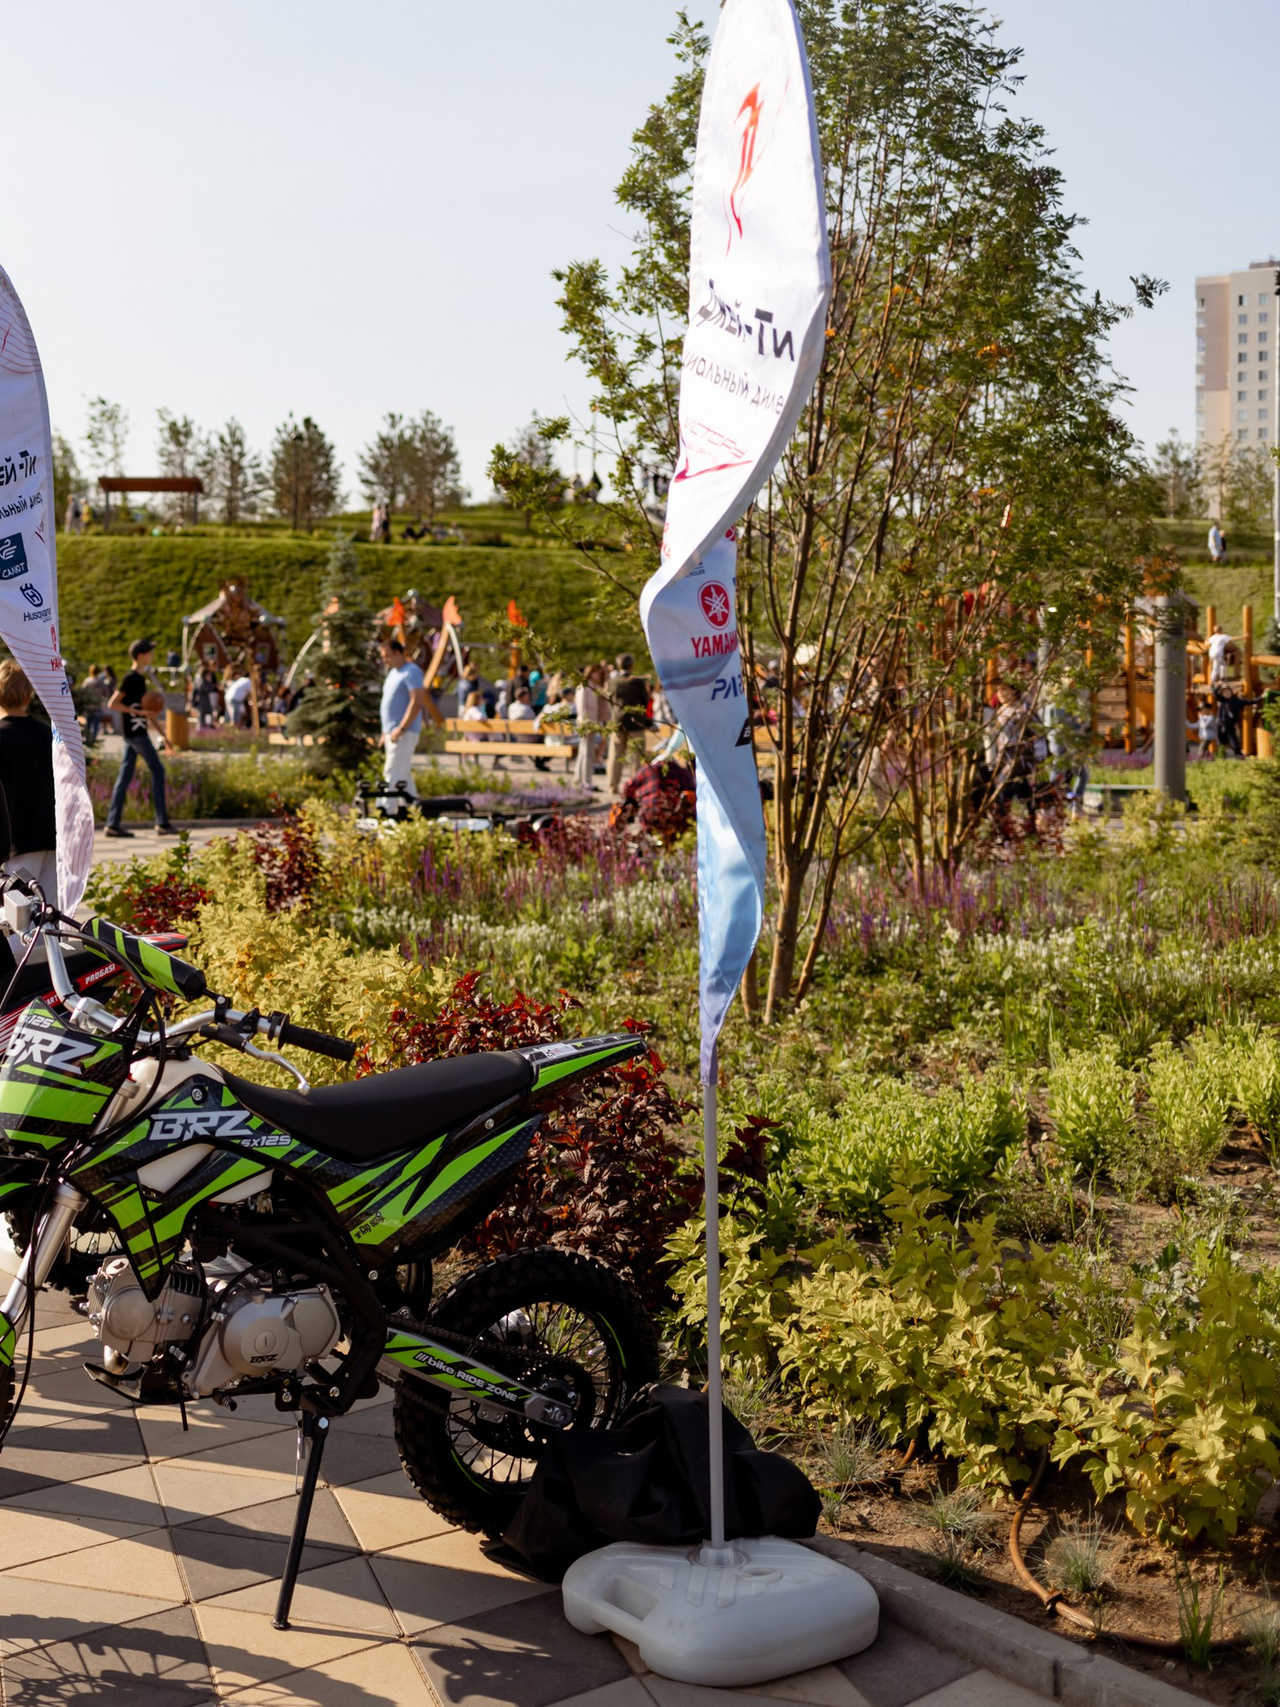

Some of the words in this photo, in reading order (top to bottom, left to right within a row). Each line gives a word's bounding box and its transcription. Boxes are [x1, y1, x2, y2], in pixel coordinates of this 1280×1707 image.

[751, 386, 784, 415] диле
[690, 630, 739, 658] YAMAH
[85, 964, 115, 985] PROGASI
[5, 1026, 96, 1075] BRZ
[150, 1110, 253, 1142] BRZ
[249, 1353, 278, 1364] BRZ
[427, 1356, 455, 1375] bike
[456, 1370, 486, 1388] RIDE
[485, 1383, 518, 1401] ZONE
